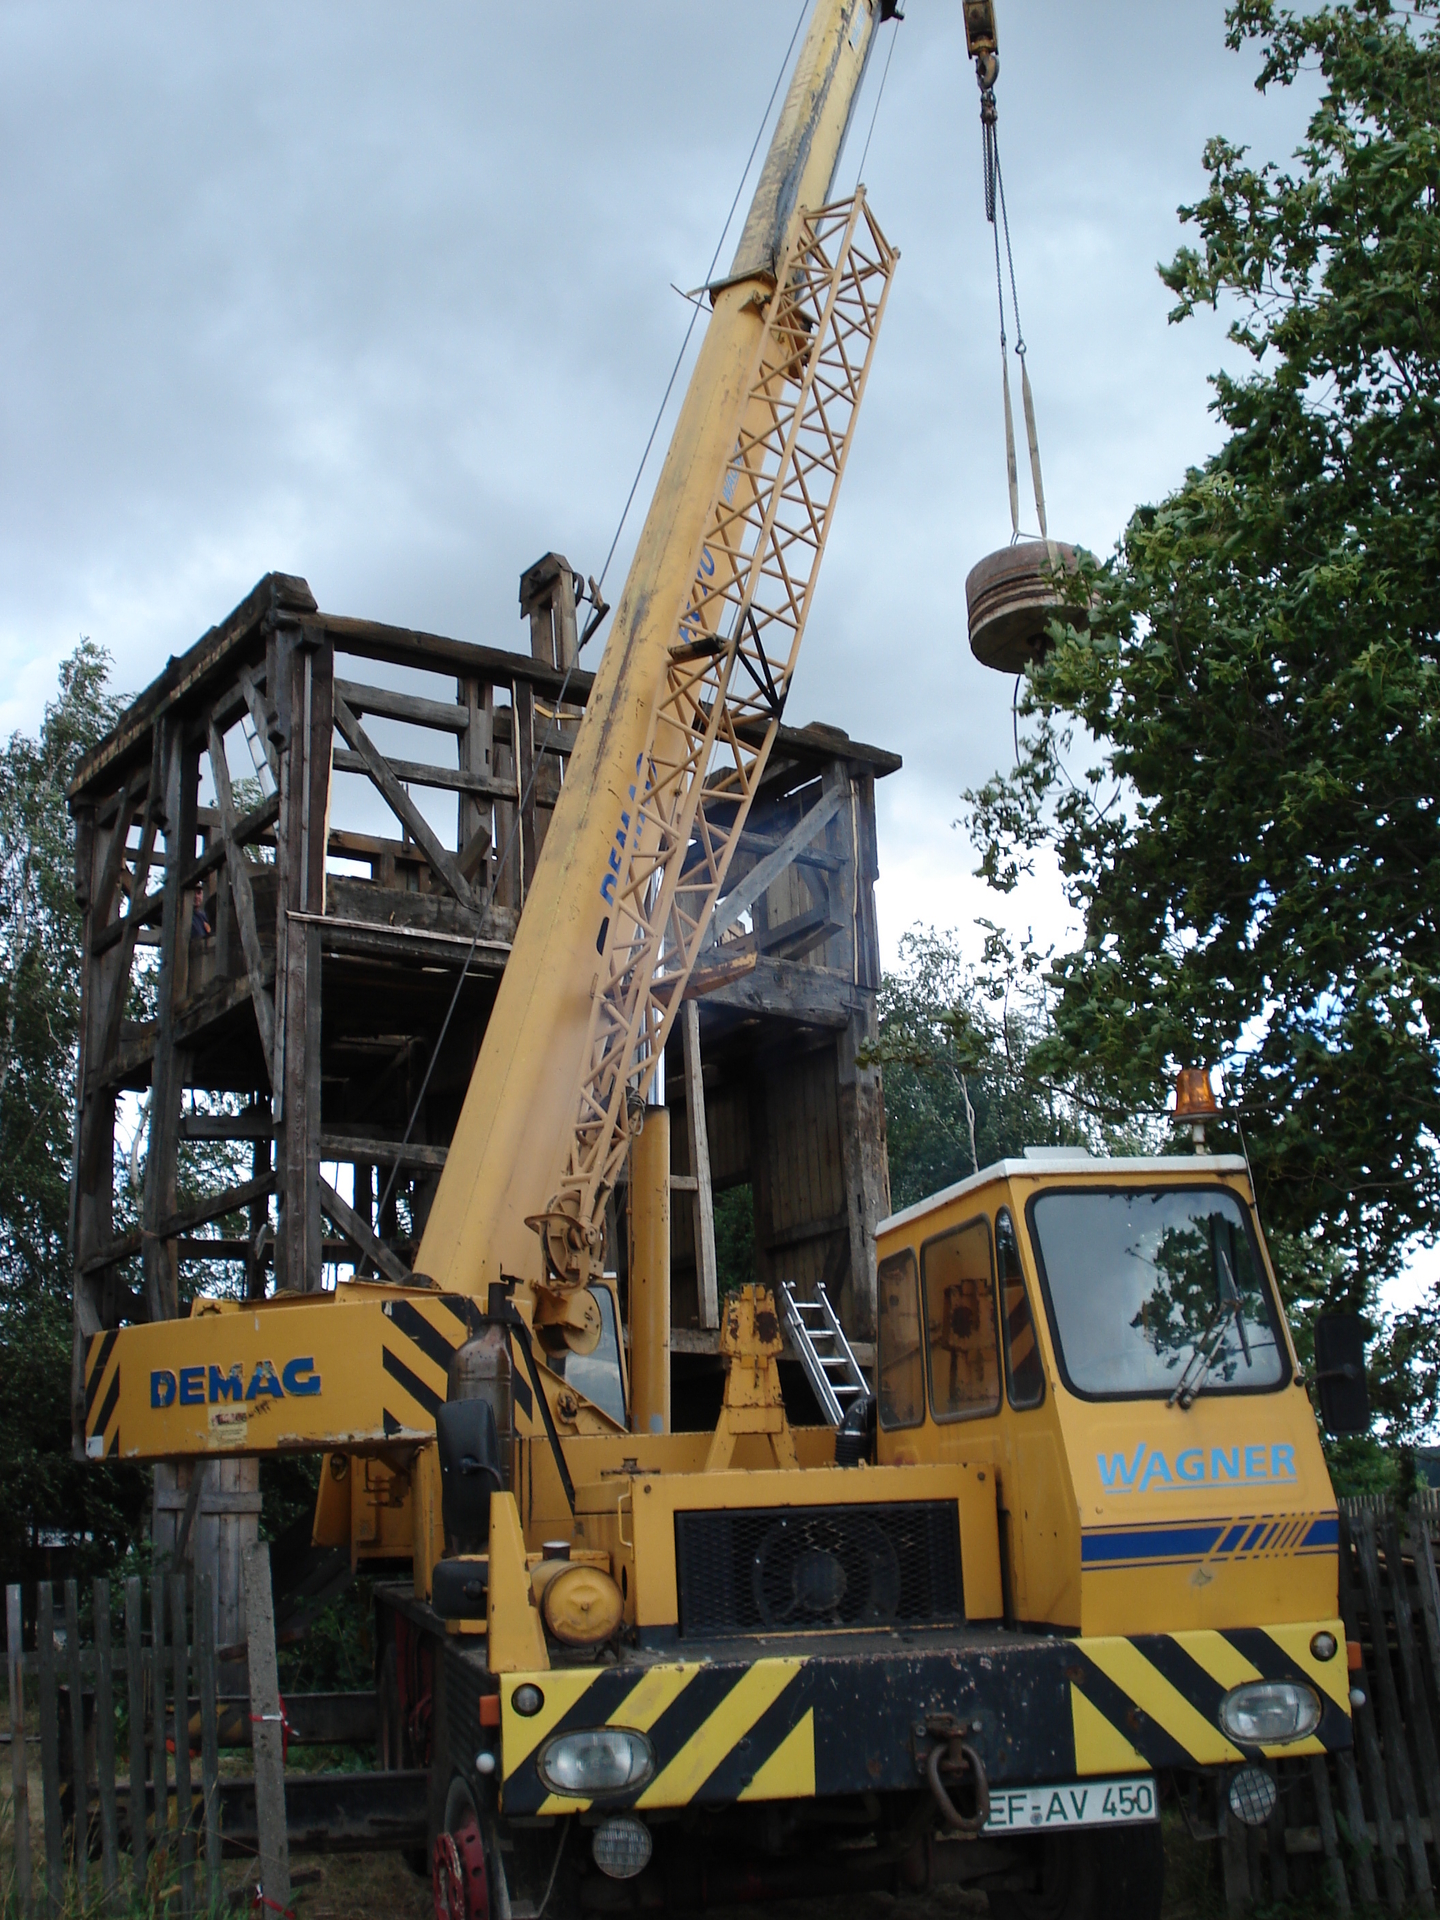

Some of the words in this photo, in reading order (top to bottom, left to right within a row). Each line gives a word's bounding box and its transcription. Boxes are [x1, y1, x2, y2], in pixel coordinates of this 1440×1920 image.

[150, 1357, 321, 1409] DEMAG
[1097, 1443, 1297, 1492] WAGNER
[1102, 1785, 1153, 1817] 450
